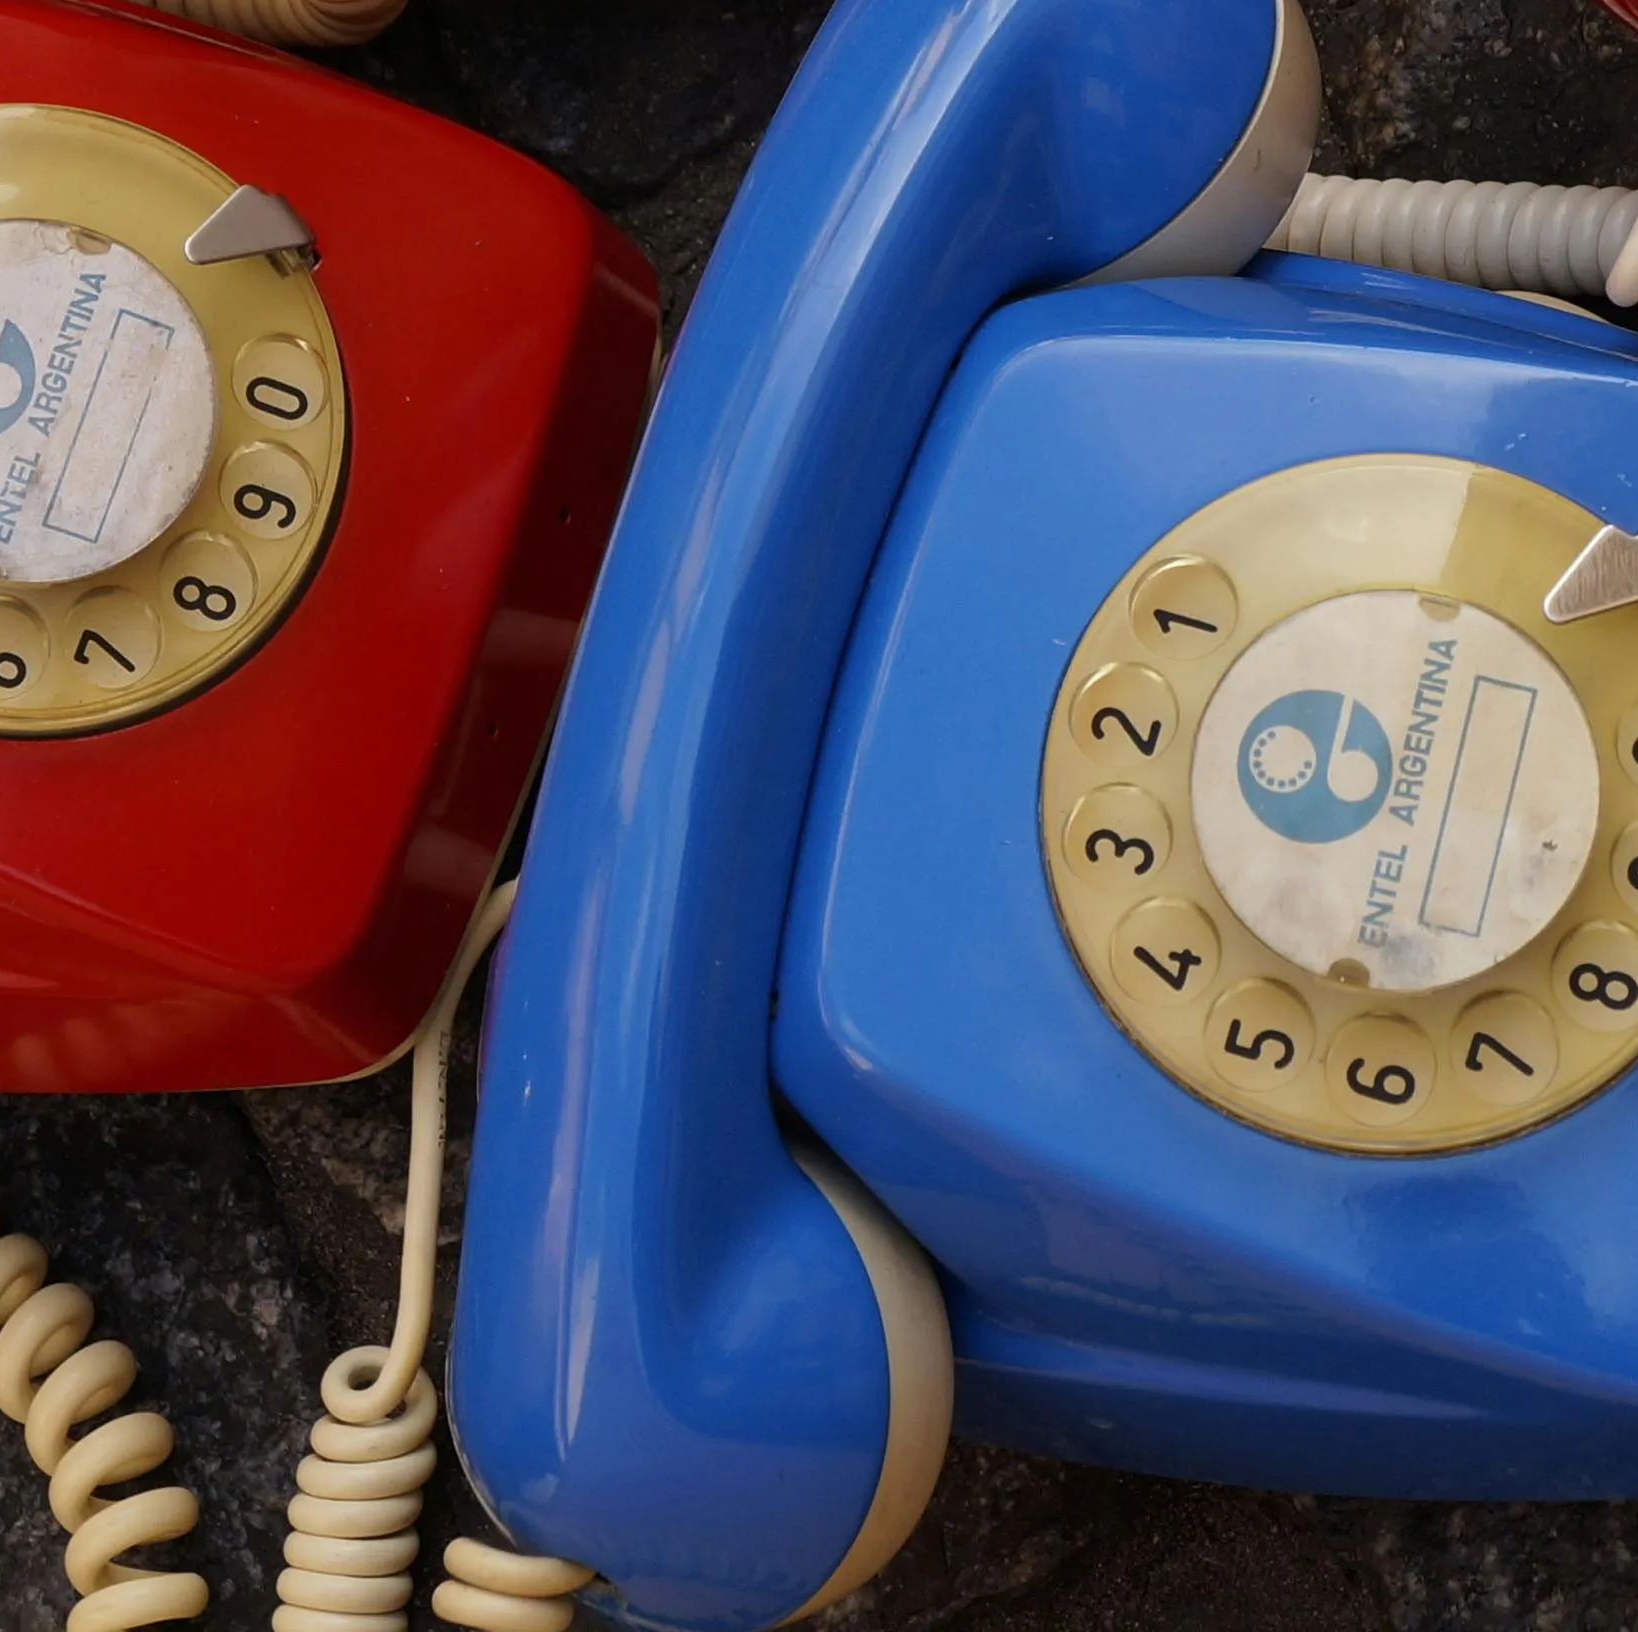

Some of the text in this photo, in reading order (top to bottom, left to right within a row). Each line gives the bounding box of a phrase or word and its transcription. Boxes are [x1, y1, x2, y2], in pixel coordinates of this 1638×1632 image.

[35, 272, 108, 437] ARGENTINA
[245, 376, 308, 420] 0
[233, 484, 296, 529] 9
[173, 575, 236, 622] 8
[1153, 608, 1218, 633] 1
[73, 629, 135, 672] 7
[1092, 707, 1161, 757] 2
[1358, 638, 1459, 947] ENTEL ARGENTINA
[1085, 829, 1155, 876] 3
[1133, 945, 1202, 991] 4
[1224, 1018, 1295, 1069] 5
[1464, 1031, 1534, 1077] 7
[1346, 1058, 1416, 1105] 6
